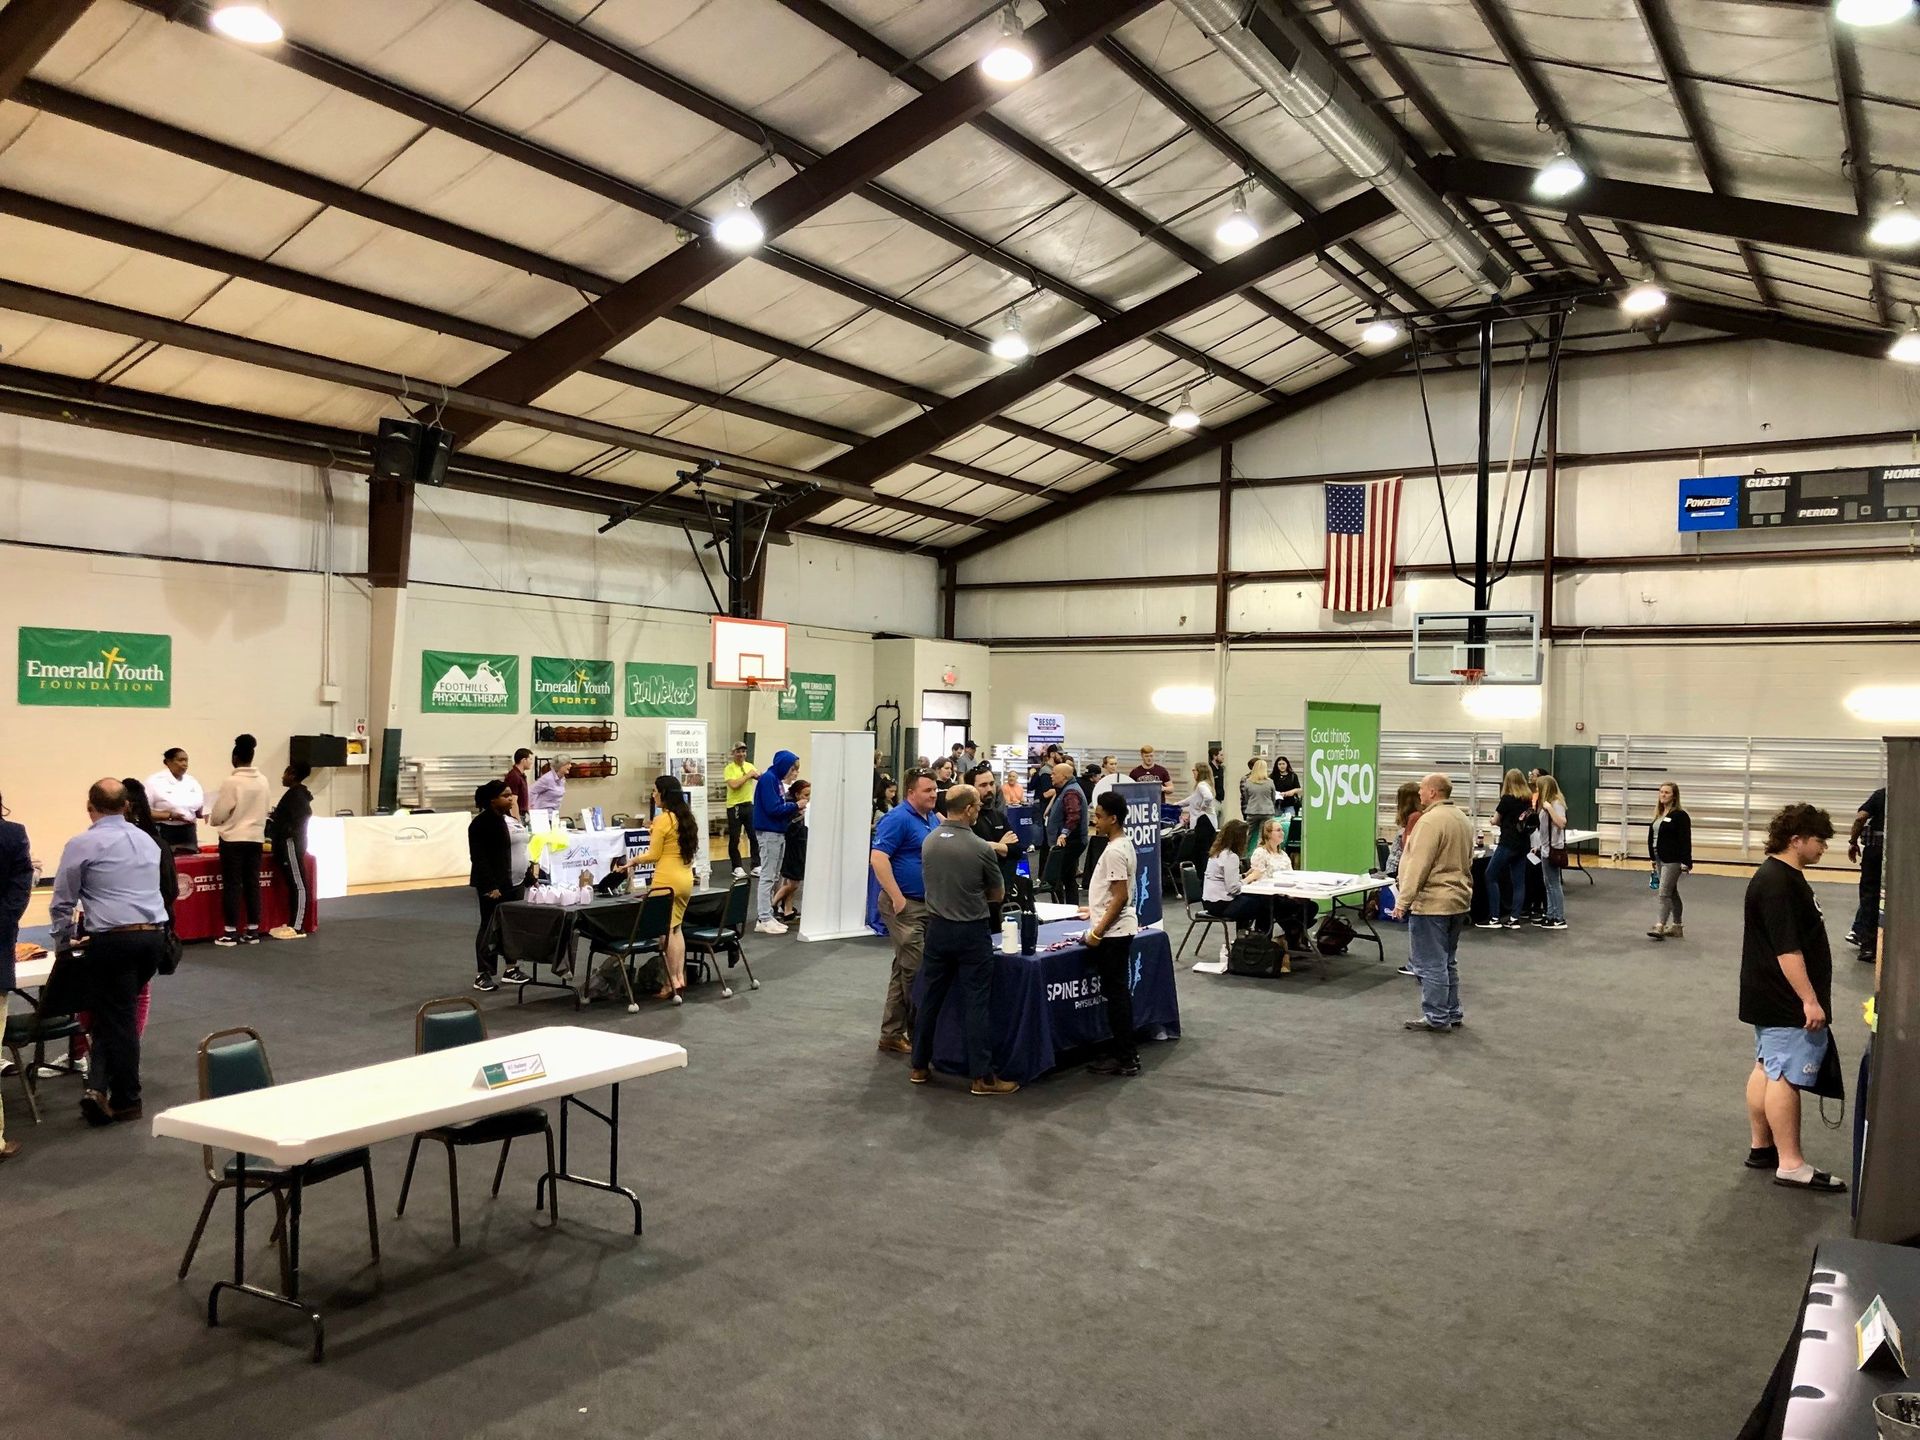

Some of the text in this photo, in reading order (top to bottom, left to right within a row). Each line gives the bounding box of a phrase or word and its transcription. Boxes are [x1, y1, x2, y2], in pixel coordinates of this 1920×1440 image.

[1882, 469, 1920, 480] HOME
[1745, 476, 1790, 488] GUEST
[1798, 508, 1838, 518] PERIOD
[26, 660, 164, 681] Emerald Youth
[40, 680, 153, 691] FOUNDATION
[440, 682, 489, 692] FOOTHILLS
[535, 679, 610, 694] Emerald Youth
[432, 692, 509, 704] PHYSICAL THERAPY
[552, 696, 597, 705] SPORTS
[1039, 718, 1057, 726] BESCO
[1310, 728, 1351, 747] Good things
[676, 740, 699, 748] WE BUILD
[1327, 749, 1345, 760] come
[1310, 749, 1374, 820] Sysco
[1124, 803, 1159, 824] PINE &
[1123, 825, 1157, 845] PORT
[583, 857, 598, 867] USA
[194, 875, 214, 883] CITY
[196, 884, 216, 892] FIRE
[1046, 980, 1080, 1001] SPINE
[1081, 978, 1088, 996] &
